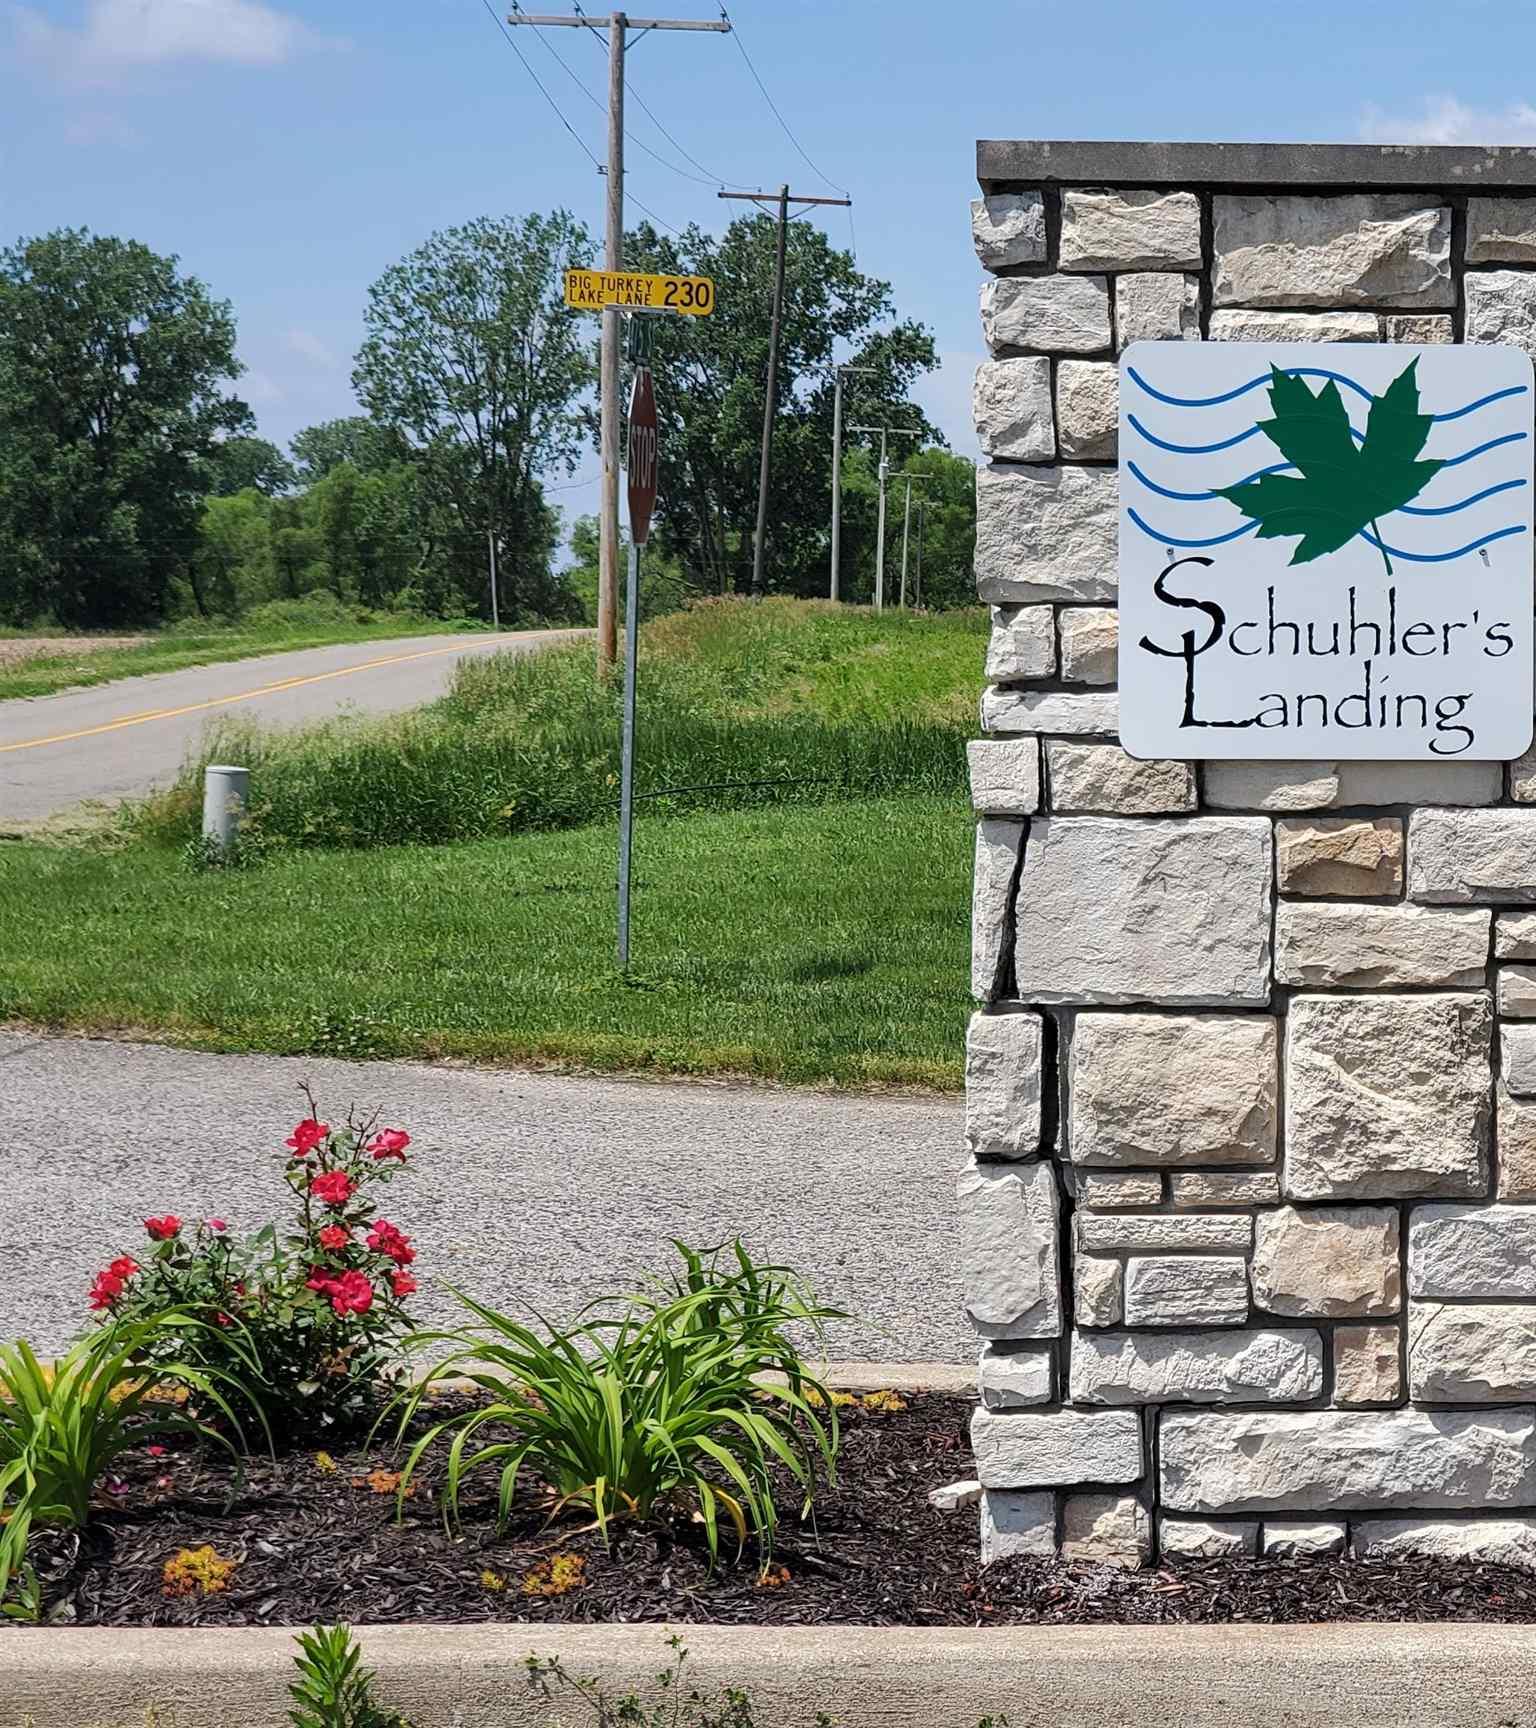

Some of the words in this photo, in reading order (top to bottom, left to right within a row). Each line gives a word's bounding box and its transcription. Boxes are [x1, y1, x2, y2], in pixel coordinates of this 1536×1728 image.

[569, 275, 591, 289] BIG
[600, 277, 653, 293] TURKEY
[569, 289, 604, 304] LAKE
[616, 293, 652, 306] LANE
[664, 281, 710, 308] 230
[630, 425, 656, 488] STOP
[1139, 556, 1514, 658] Schuhler's
[1178, 629, 1475, 755] Landing
